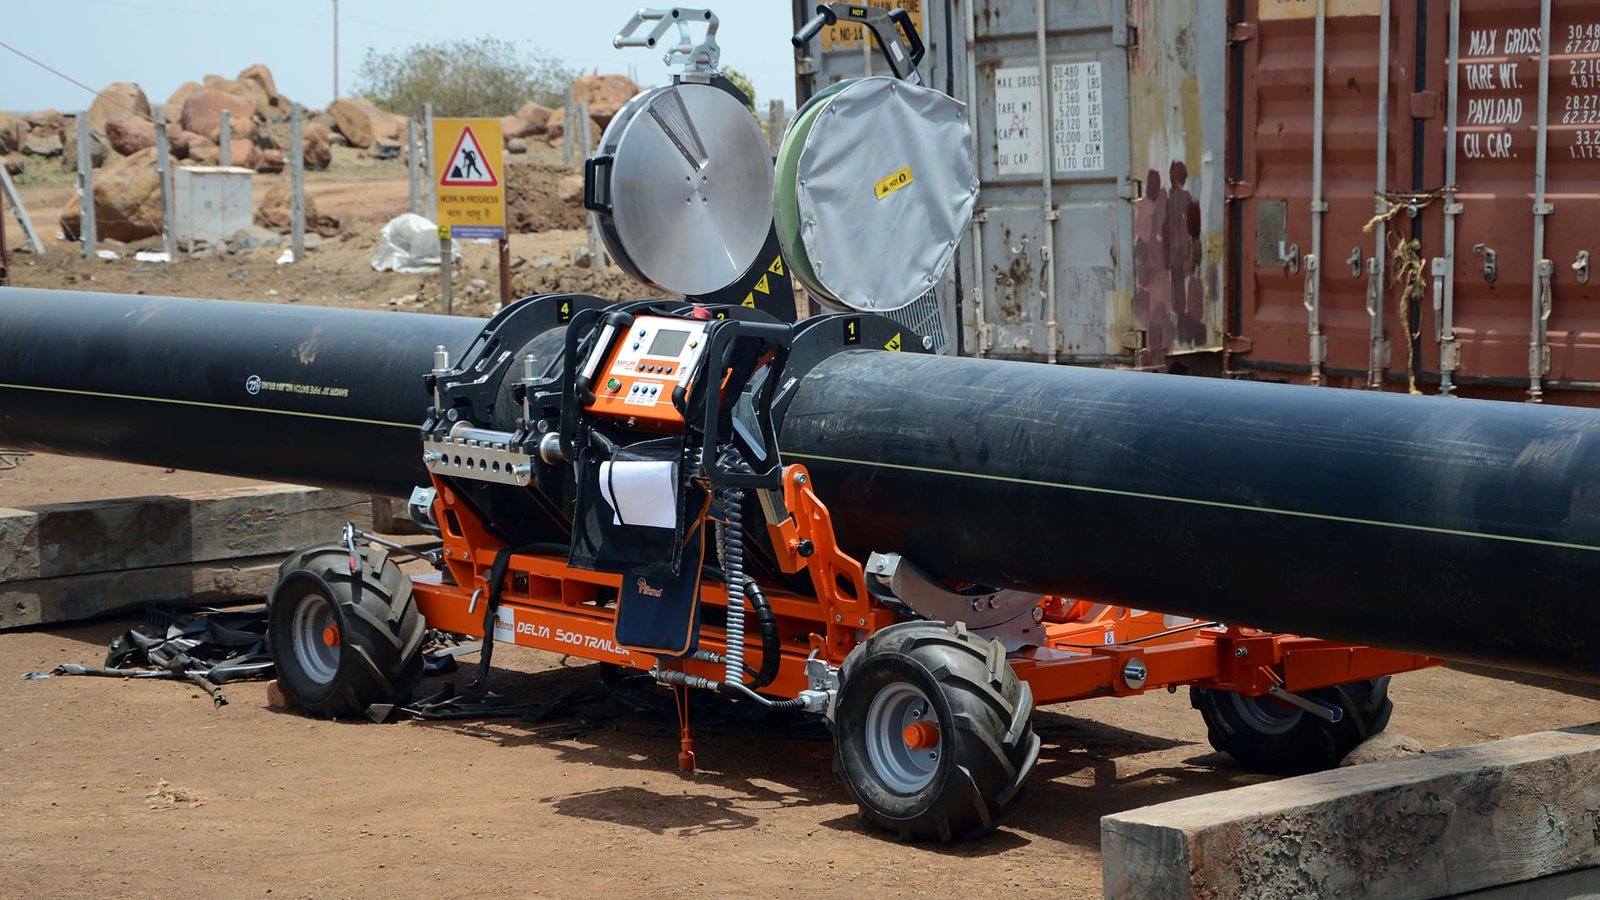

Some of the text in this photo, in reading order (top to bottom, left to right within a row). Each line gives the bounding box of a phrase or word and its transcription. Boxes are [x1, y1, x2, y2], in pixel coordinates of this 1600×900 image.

[852, 8, 864, 16] HOT
[1468, 29, 1497, 56] MAX
[1053, 64, 1096, 79] 30.480 KG
[1465, 63, 1523, 90] TARE WT.
[1053, 77, 1101, 92] 67.200 LBS
[1059, 90, 1097, 104] 2.360 KG
[998, 102, 1016, 115] TARE
[1059, 103, 1101, 117] 5.200 LBS
[1466, 98, 1523, 125] PAYLOAD
[1055, 116, 1098, 131] 28.120 KG
[998, 128, 1013, 141] CAP
[1055, 129, 1102, 144] 62.000 LBS
[1060, 144, 1077, 156] 33.2
[1463, 132, 1517, 158] CU. CAP.
[1014, 153, 1029, 166] CAP
[1057, 157, 1077, 169] 1.170
[441, 195, 457, 203] WORK
[466, 195, 498, 204] PROGRESS
[560, 302, 569, 314] 4
[848, 321, 855, 335] 1
[517, 621, 550, 639] DELTA
[554, 628, 583, 645] 500
